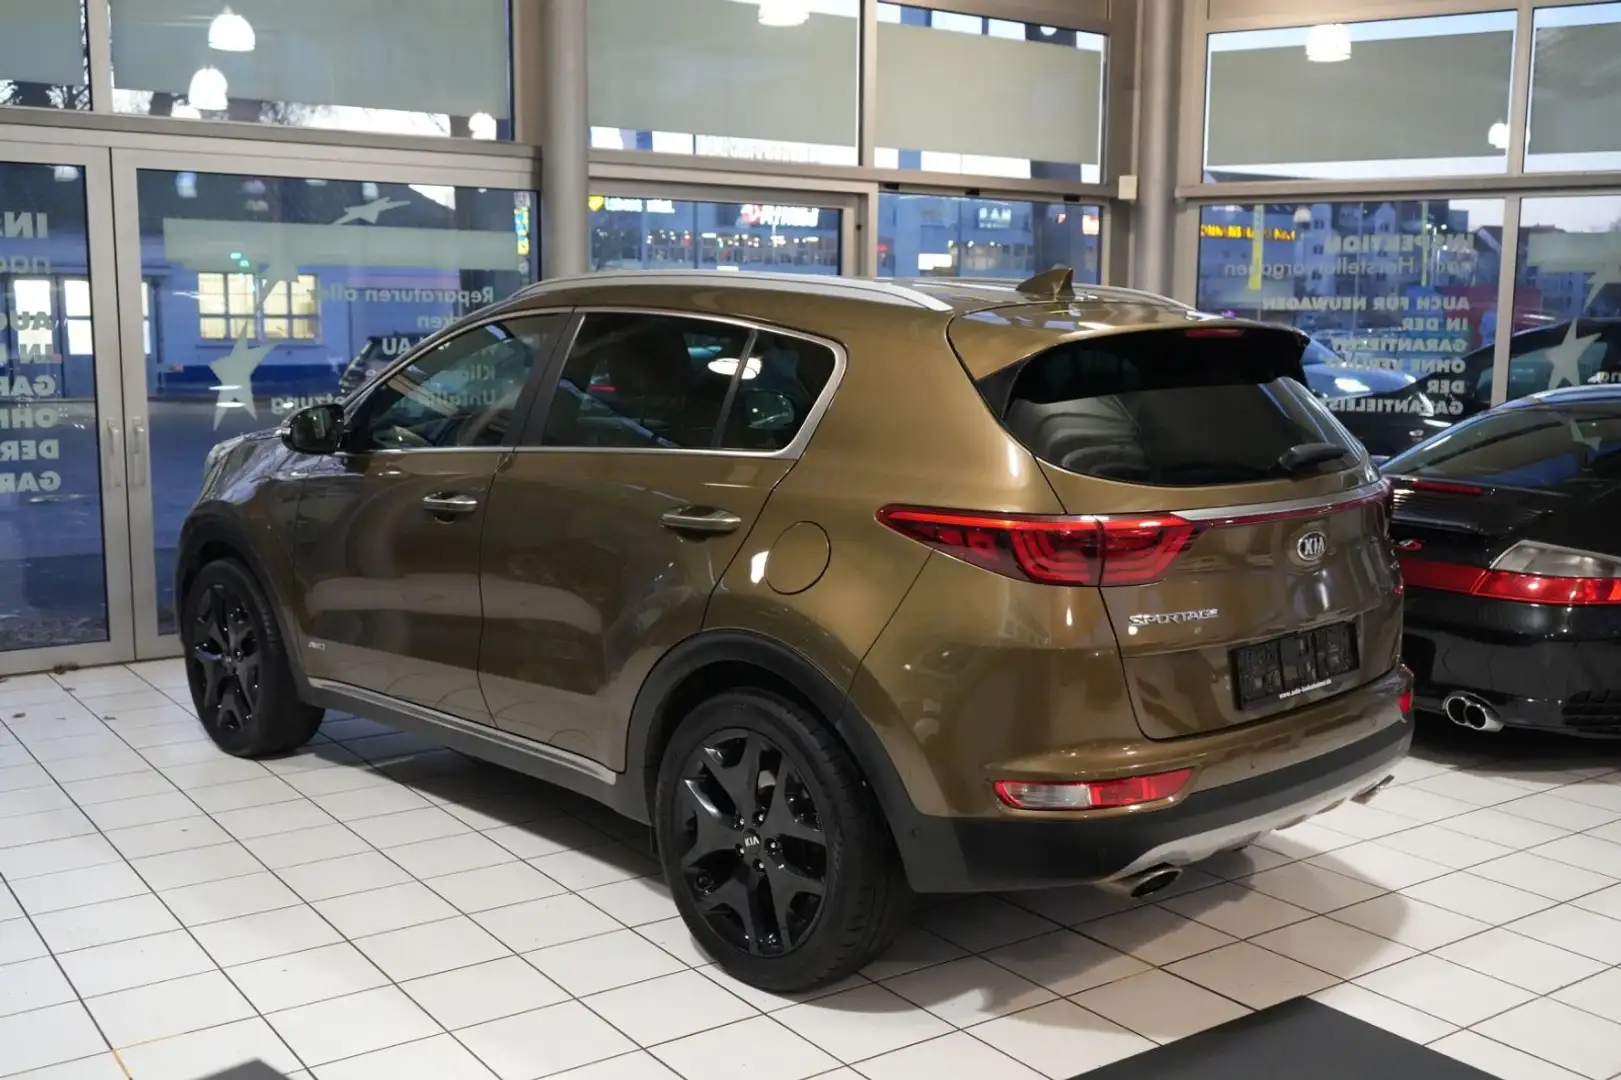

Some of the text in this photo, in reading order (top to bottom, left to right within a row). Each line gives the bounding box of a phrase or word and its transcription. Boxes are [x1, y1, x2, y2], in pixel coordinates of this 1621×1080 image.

[1304, 536, 1325, 555] KIA
[1129, 608, 1219, 627] SPORTAGE
[744, 835, 760, 848] KIA
